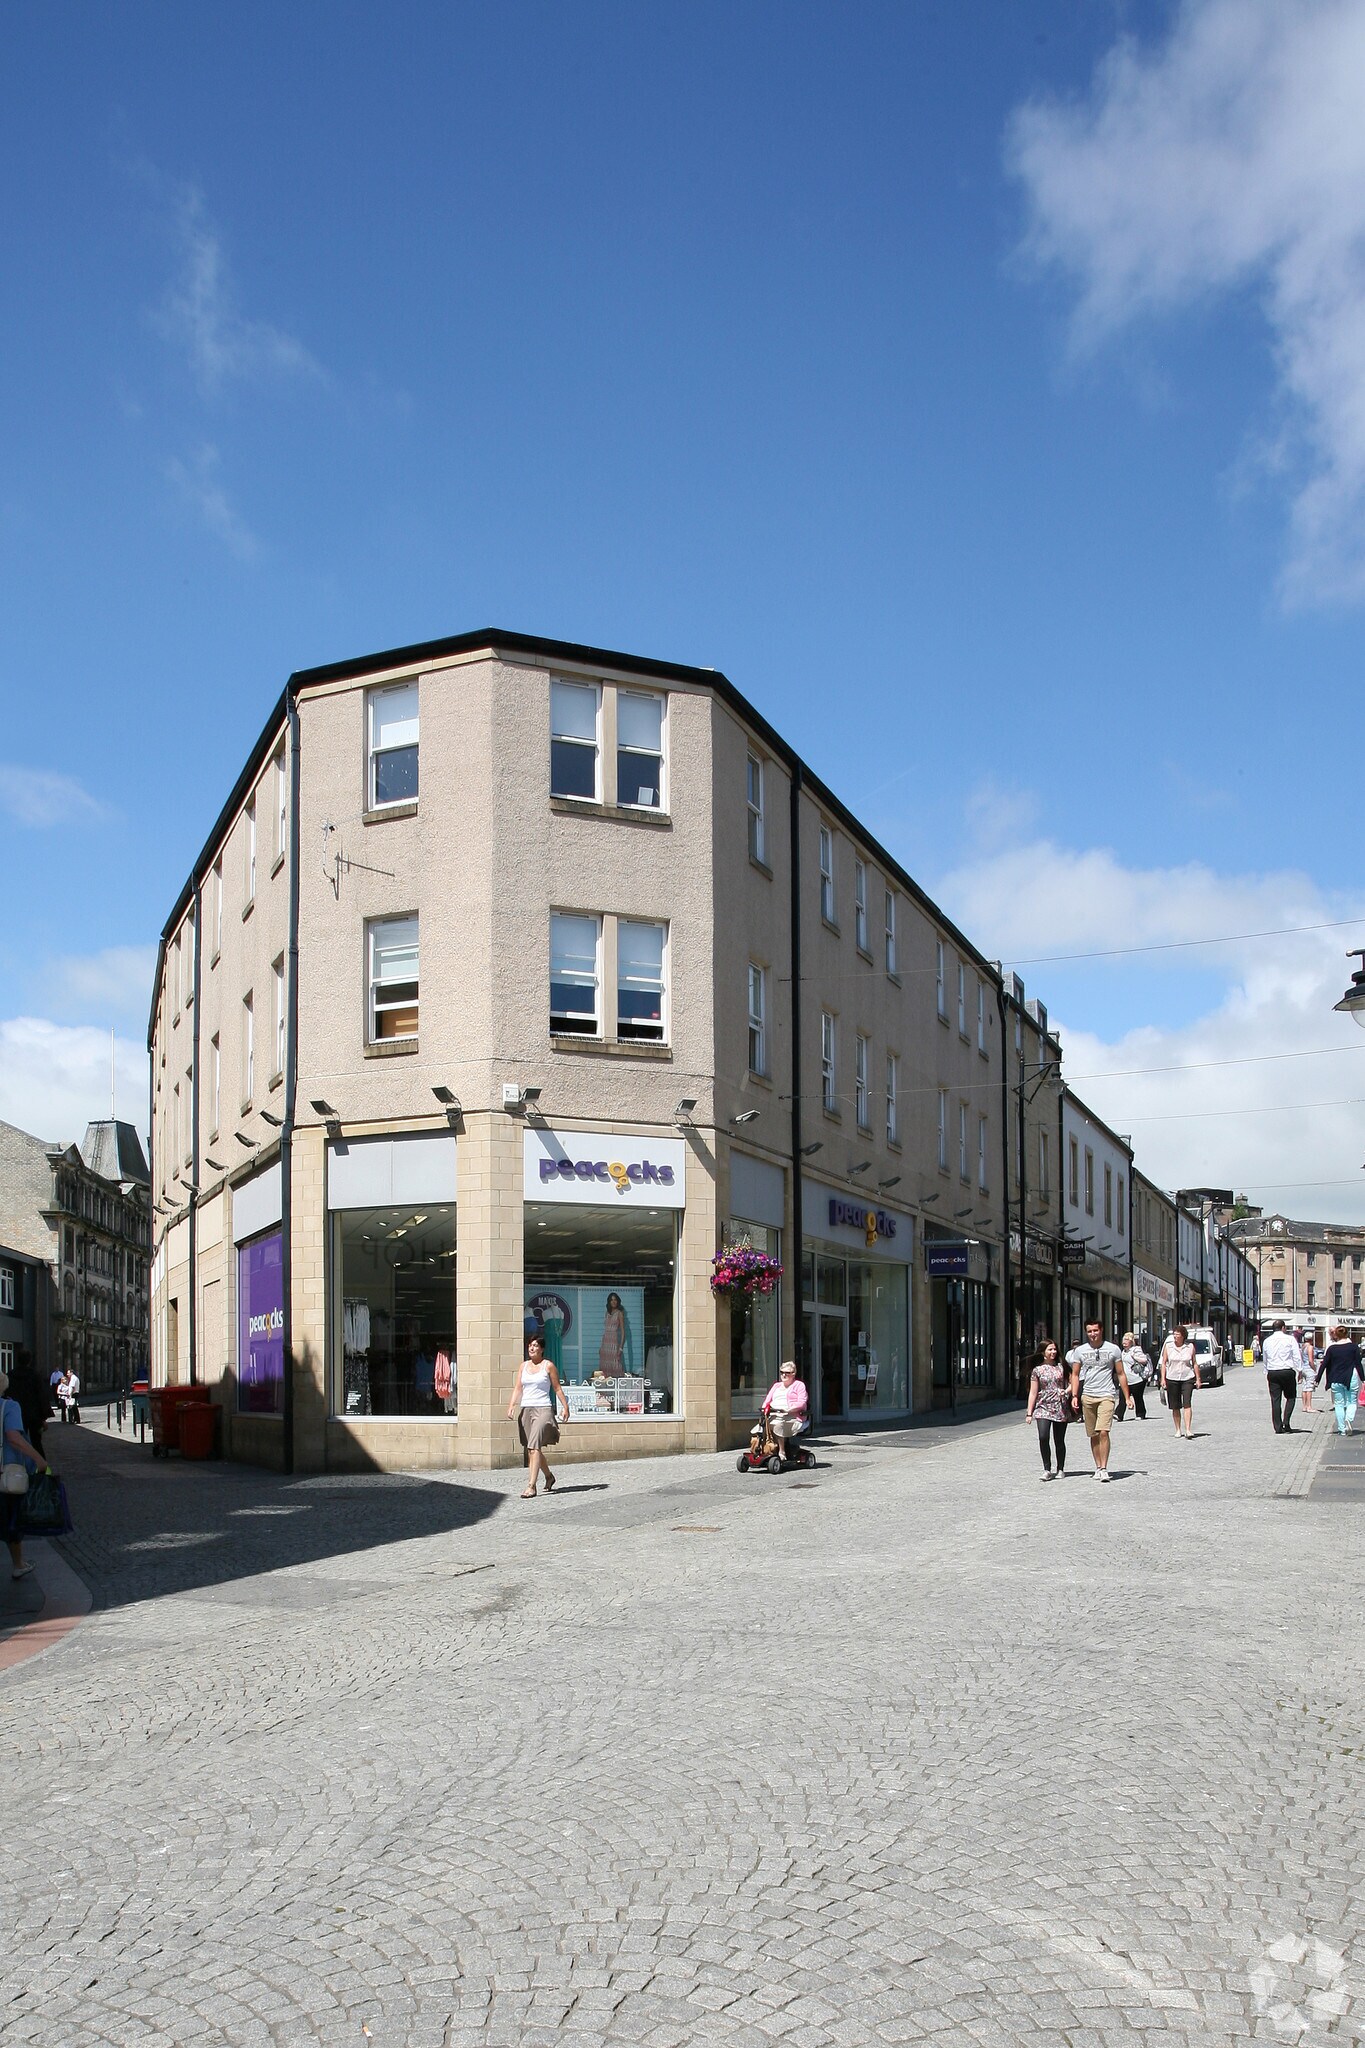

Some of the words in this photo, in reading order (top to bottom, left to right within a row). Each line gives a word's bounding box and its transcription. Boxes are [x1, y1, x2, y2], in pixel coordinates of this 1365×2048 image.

[539, 1158, 673, 1189] peacocks
[829, 1198, 897, 1246] peacocks
[931, 1256, 966, 1265] peacocks
[249, 1307, 284, 1341] peacocks
